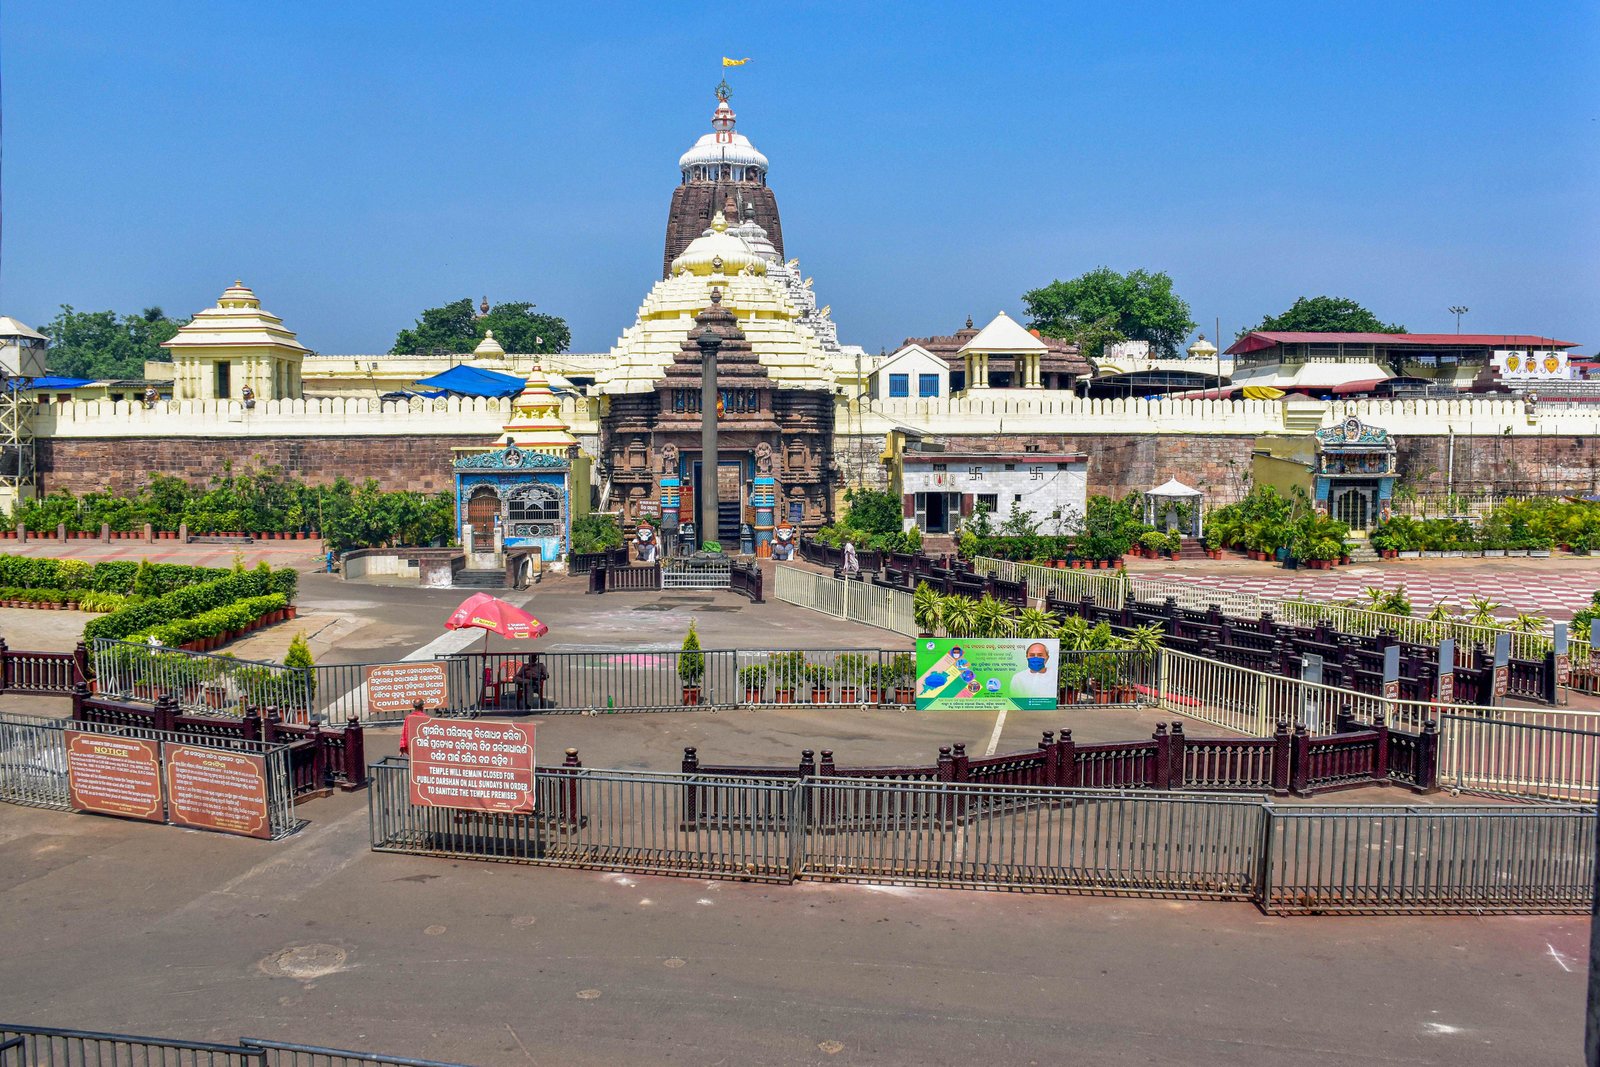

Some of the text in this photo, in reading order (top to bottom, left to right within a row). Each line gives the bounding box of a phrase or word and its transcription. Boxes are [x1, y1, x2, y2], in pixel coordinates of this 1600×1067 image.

[94, 746, 128, 756] NOTICE
[455, 739, 478, 751] ରବିବାର
[480, 740, 490, 750] ଦିନ
[429, 767, 448, 776] TEMPLE
[450, 768, 462, 776] WILL
[462, 769, 482, 777] REMAIN
[483, 771, 503, 779] CLOSED
[436, 777, 459, 786] DARSHAN
[479, 780, 502, 789] SUNDAYS
[436, 787, 458, 796] SANITIZE
[470, 790, 490, 798] TEMPLE
[492, 791, 517, 800] PREMISES
